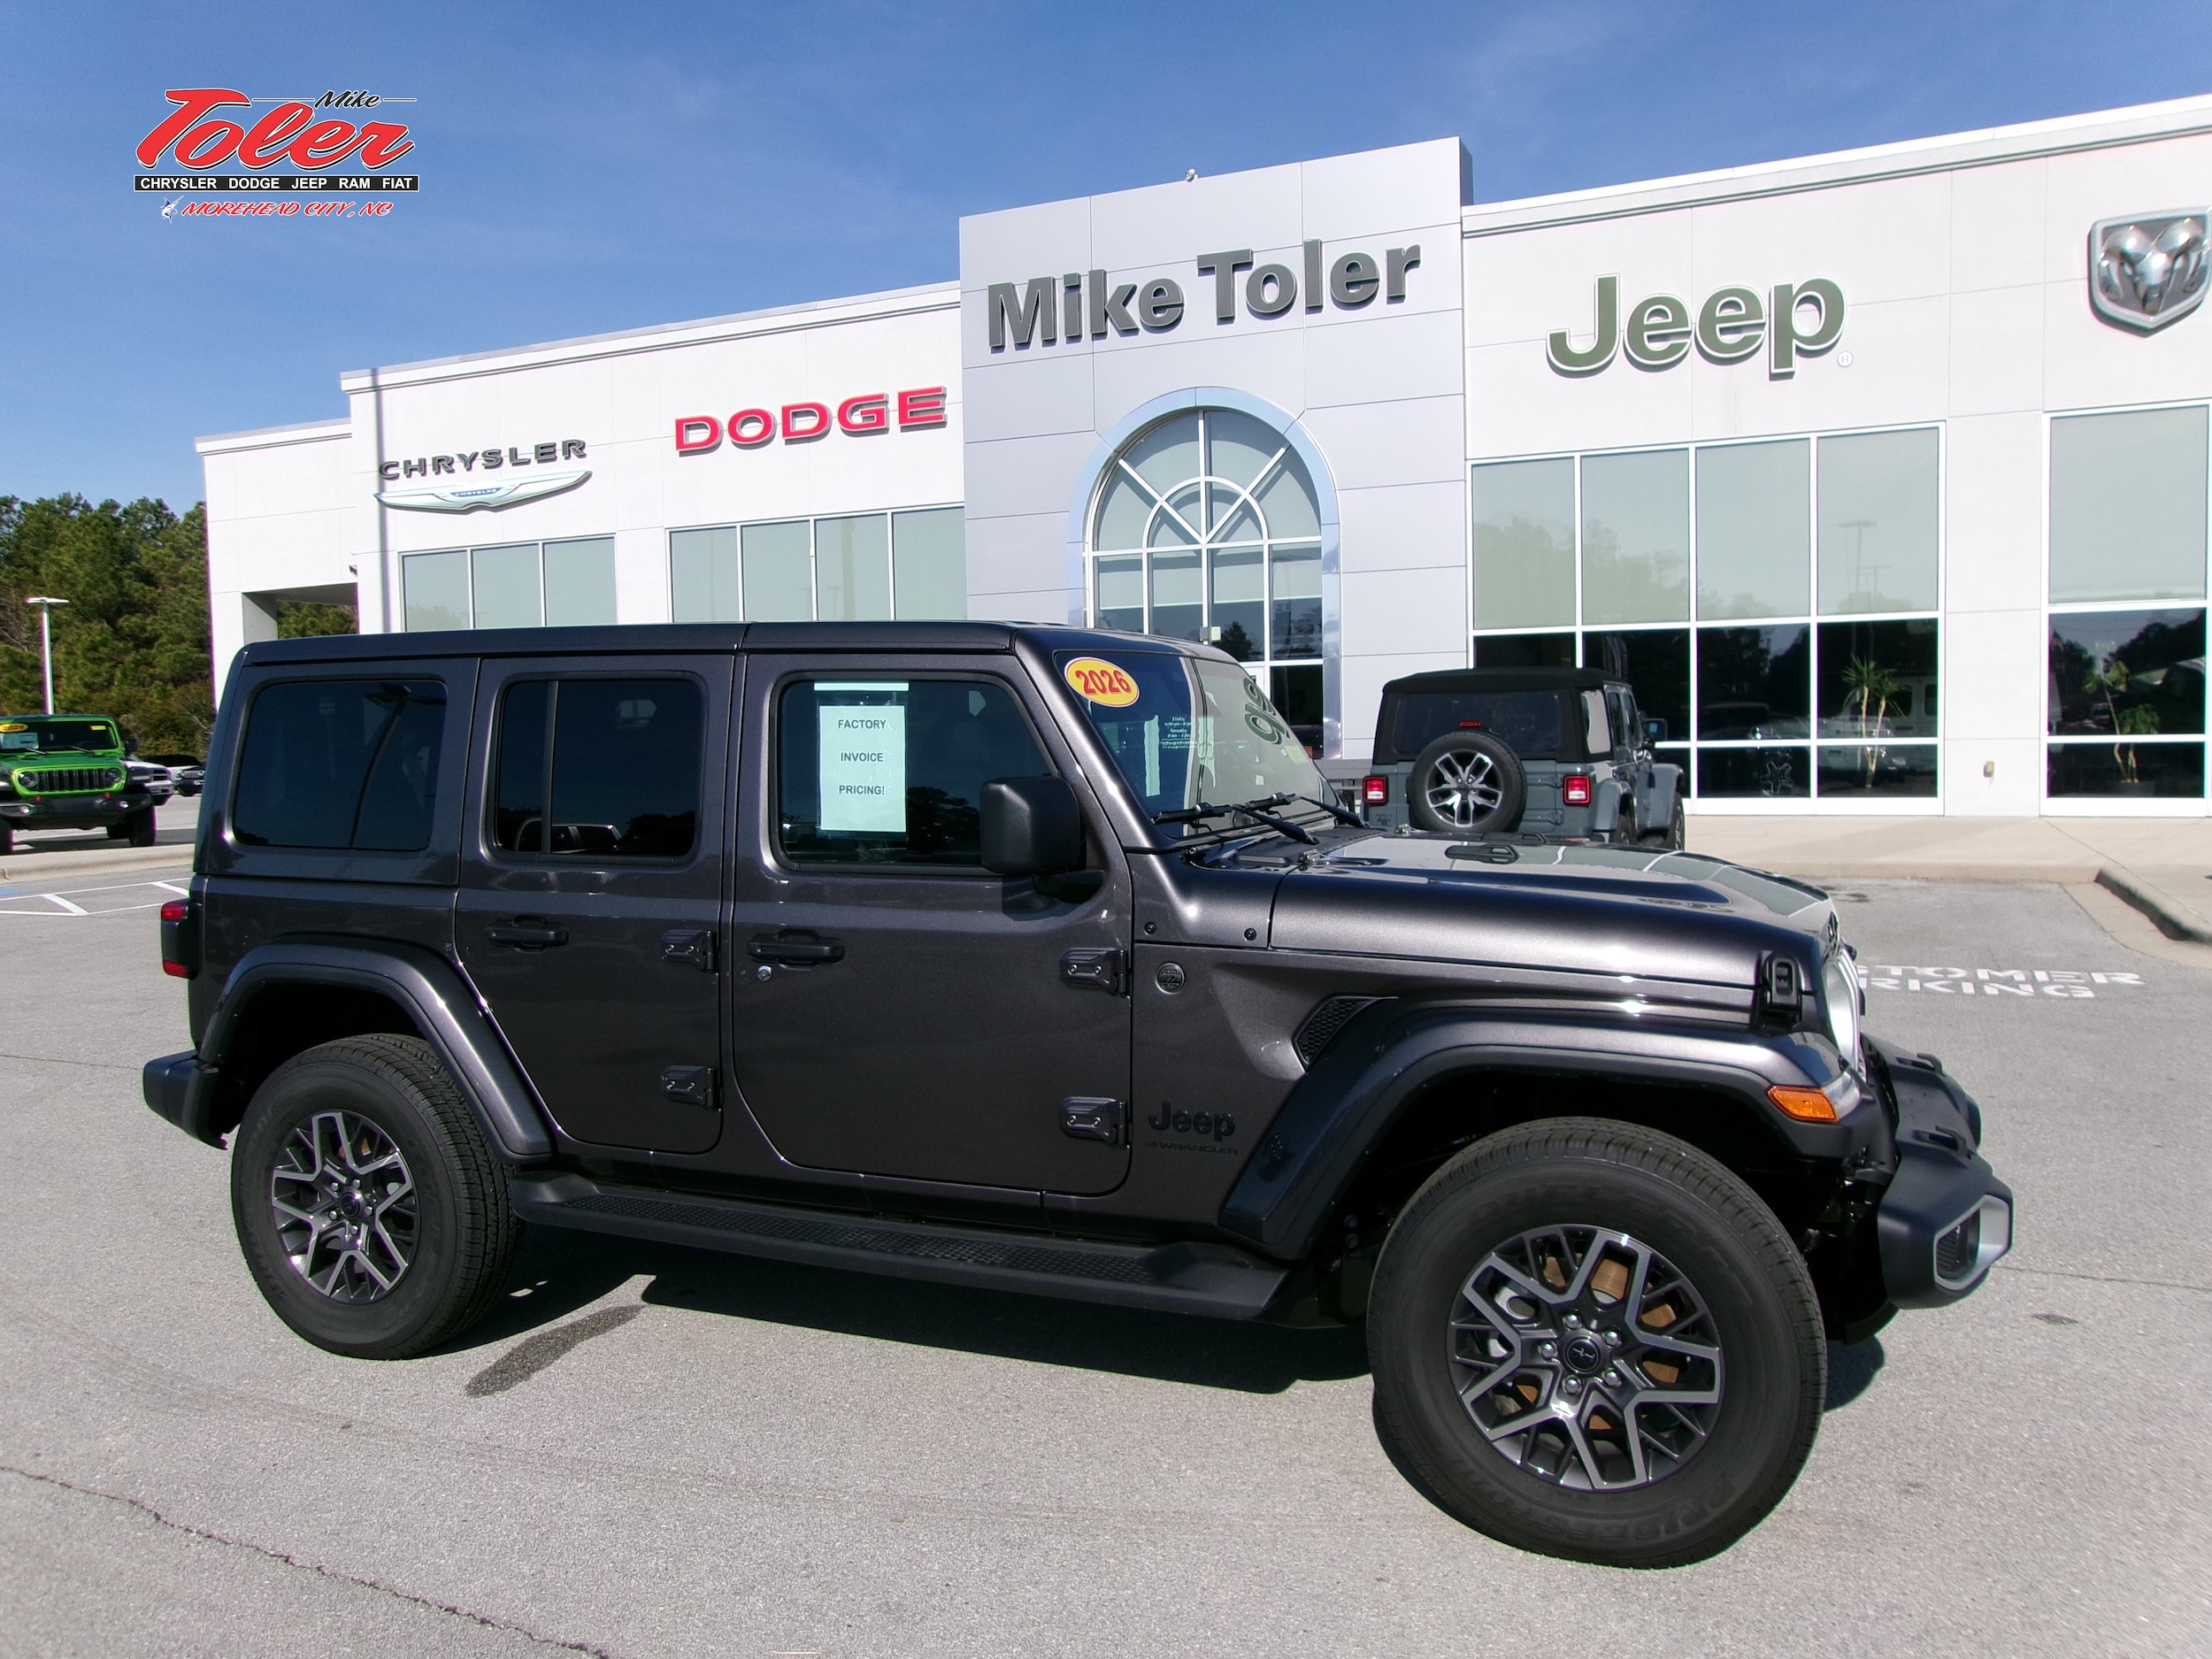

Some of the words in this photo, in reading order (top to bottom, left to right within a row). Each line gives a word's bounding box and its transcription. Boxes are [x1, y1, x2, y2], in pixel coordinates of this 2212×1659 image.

[987, 269, 1185, 353] Mike
[1196, 238, 1421, 326] Toler
[1546, 273, 1846, 380] Jeep
[674, 386, 948, 457] DODGE
[379, 439, 587, 480] CHRYSLER
[455, 488, 497, 497] CHRYSLER
[1075, 670, 1132, 695] 2026
[838, 719, 887, 729] FACTORY
[841, 752, 884, 763] INVOICE
[839, 785, 885, 795] PRICING!
[1148, 1102, 1235, 1141] Jeep
[1159, 1141, 1238, 1156] WRANGLER
